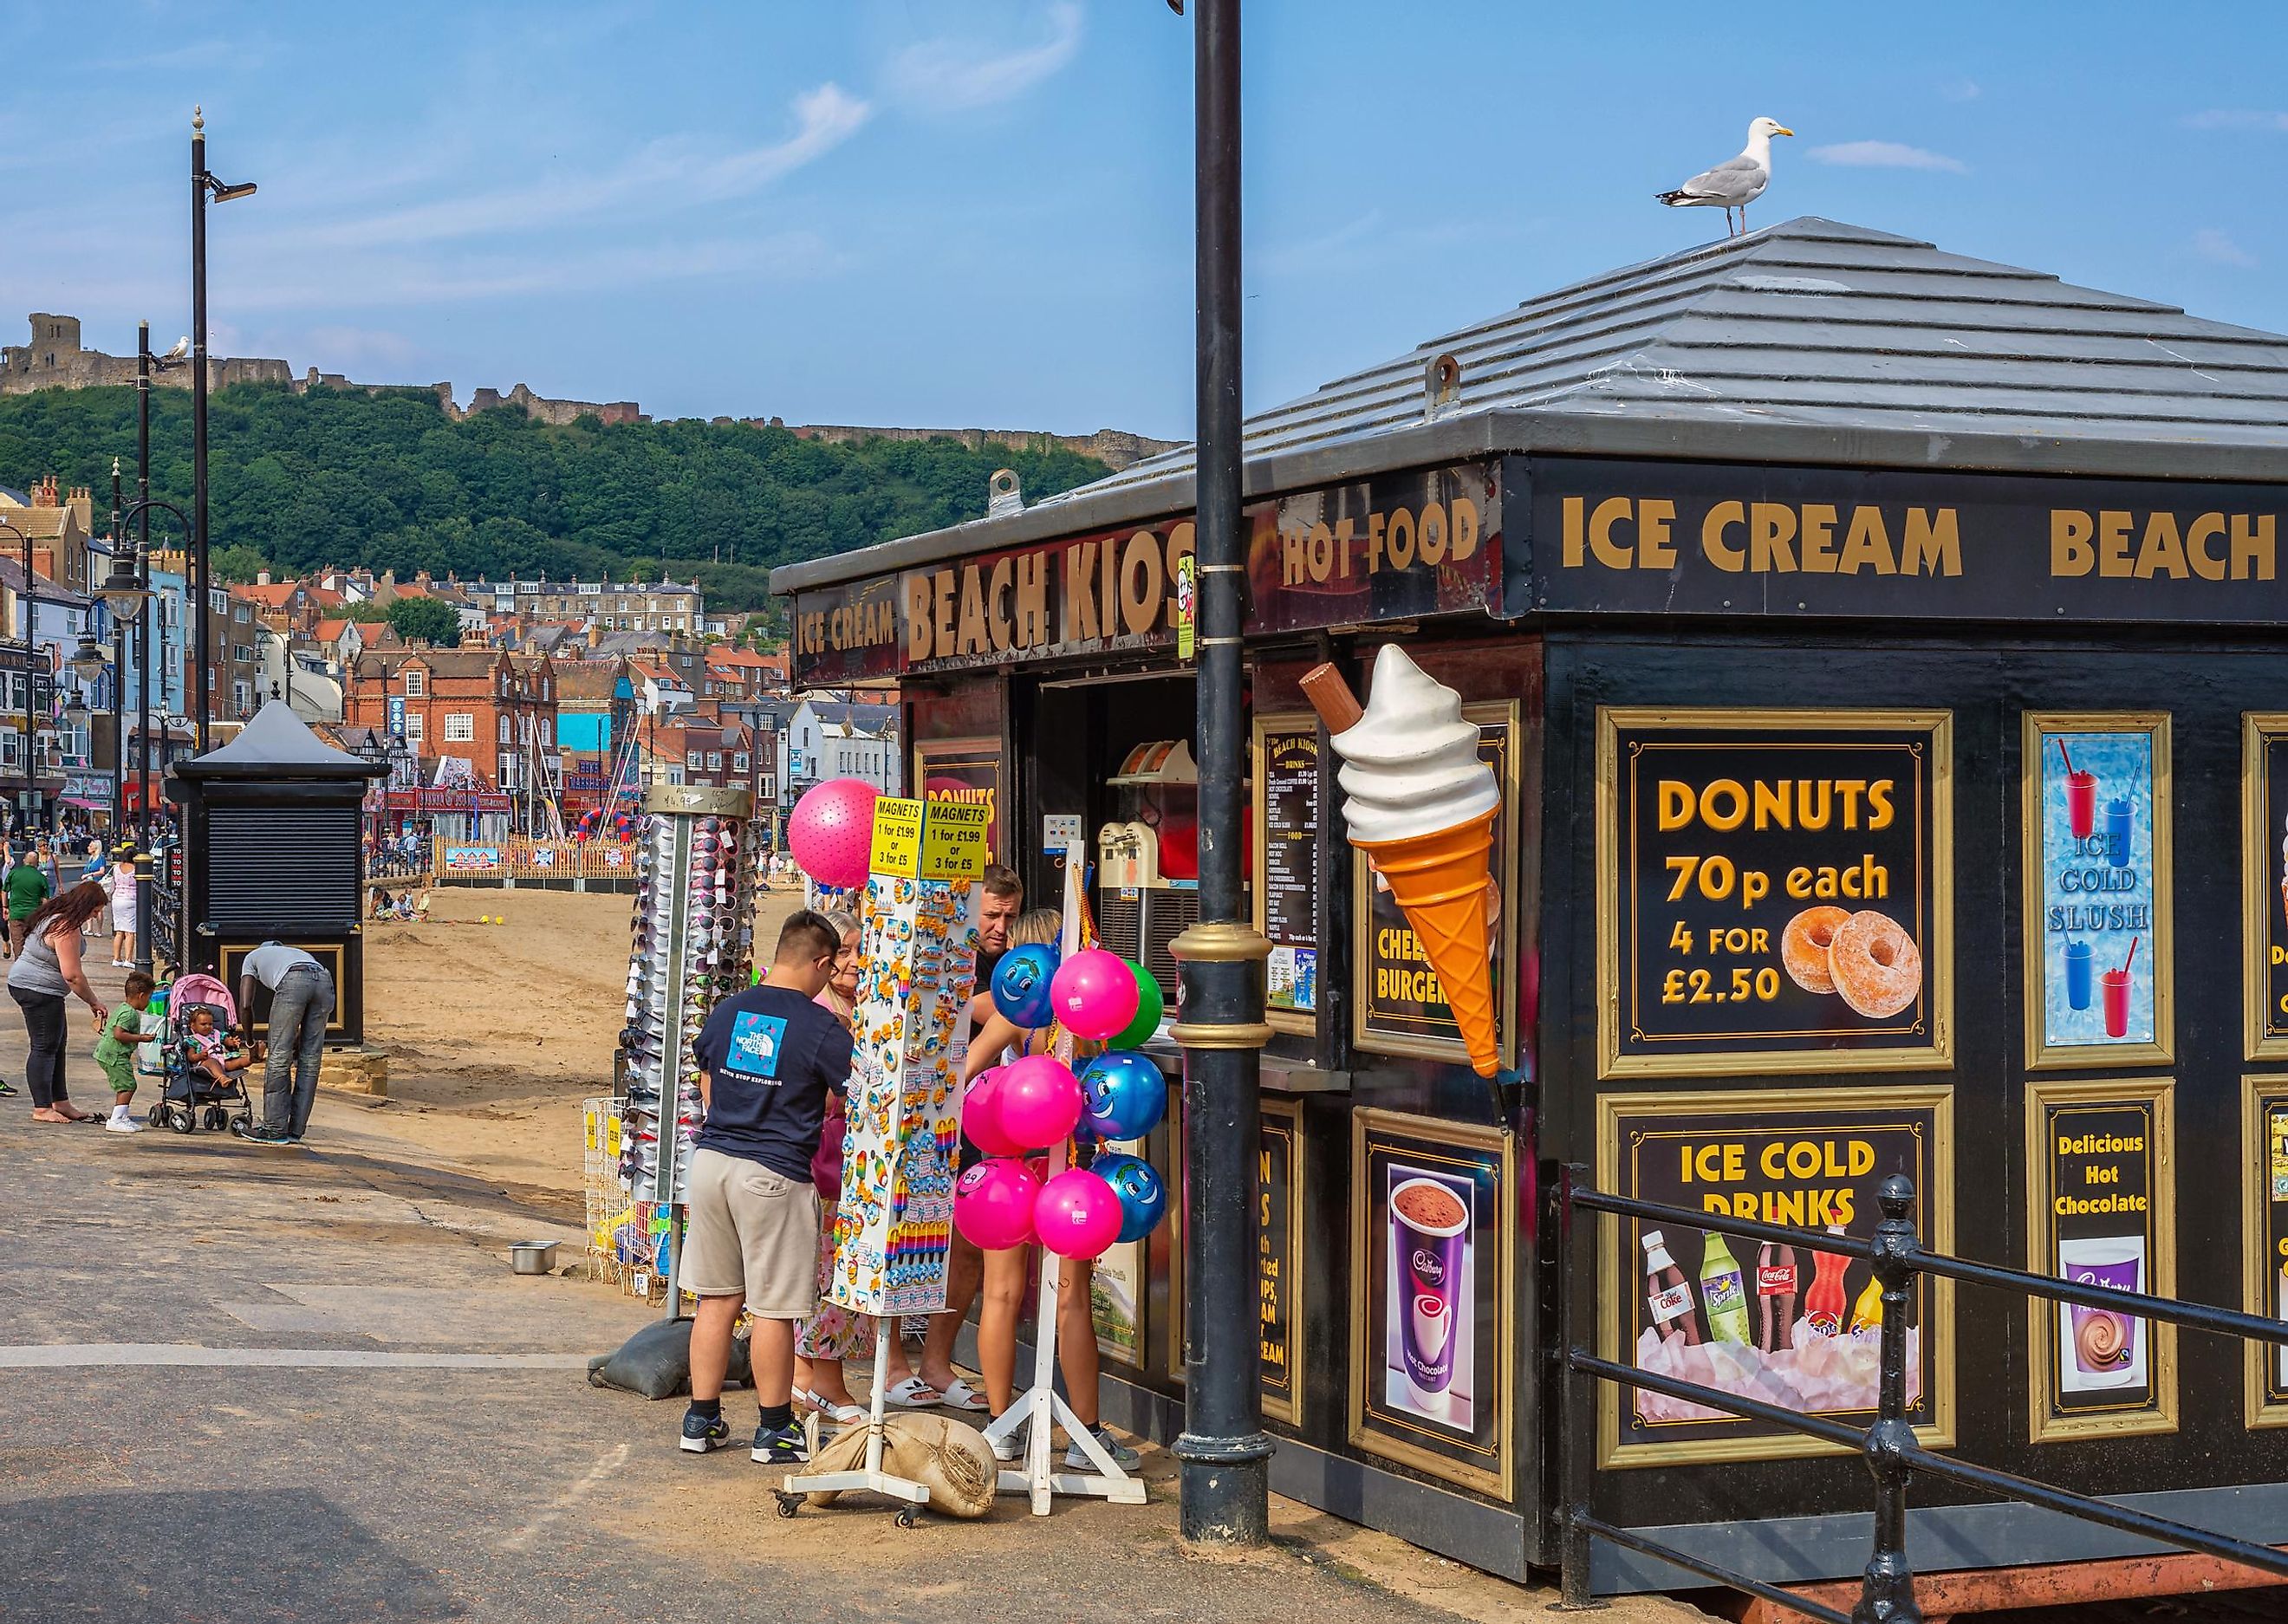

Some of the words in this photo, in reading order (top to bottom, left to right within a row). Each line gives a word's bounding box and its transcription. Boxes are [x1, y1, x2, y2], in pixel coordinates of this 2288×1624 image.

[1283, 518, 1354, 586] HOT
[1368, 497, 1478, 575] FOOD
[1563, 497, 1676, 570] ICE
[1702, 500, 1963, 578] CREAM
[2050, 509, 2275, 580] BEACH
[907, 551, 1048, 662] BEACH
[1068, 522, 1195, 641] KIOS
[797, 611, 824, 654] ICE
[831, 600, 894, 651] CREAM
[1273, 737, 1296, 758] BEACH
[1285, 760, 1305, 769] DRINKS
[878, 801, 920, 818] MAGNETS
[930, 806, 985, 822] MAGNETS
[1659, 778, 1895, 832] DONUTS
[878, 823, 882, 835] 1
[884, 824, 894, 836] for
[897, 825, 915, 839] £1.99
[932, 829, 936, 840] 1
[940, 829, 953, 841] for
[957, 830, 980, 842] £1.99
[950, 846, 959, 855] or
[2074, 832, 2122, 857] ICE
[880, 852, 883, 862] 3
[887, 853, 896, 865] for
[899, 854, 907, 866] £5
[935, 857, 941, 868] 3
[945, 857, 959, 869] for
[961, 859, 972, 870] £5
[1786, 854, 1889, 900] each
[2059, 867, 2135, 893] COLD
[2048, 904, 2148, 932] SLUSH
[1378, 928, 1429, 962] CHEE
[1668, 920, 1694, 955] 4
[1709, 927, 1770, 955] FOR
[1661, 967, 1780, 1005] £2.50
[736, 1036, 763, 1049] NORTH
[749, 1031, 763, 1040] THE
[742, 1045, 763, 1056] FACE
[719, 1068, 734, 1078] NEVER
[735, 1073, 751, 1082] STOP
[751, 1077, 783, 1087] EXPLORING
[2058, 1132, 2144, 1157] Delicious
[1681, 1144, 1746, 1182] ICE
[1760, 1140, 1875, 1179] COLD
[2085, 1164, 2118, 1185] Hot
[1703, 1188, 1855, 1227] DRINKS
[2055, 1192, 2148, 1215] Chocolate
[1413, 1250, 1443, 1277] Cadbury
[1660, 1294, 1683, 1309] Coke
[1664, 1289, 1677, 1301] Diet
[1712, 1286, 1738, 1306] Sprite
[1417, 1361, 1448, 1375] Chocolate
